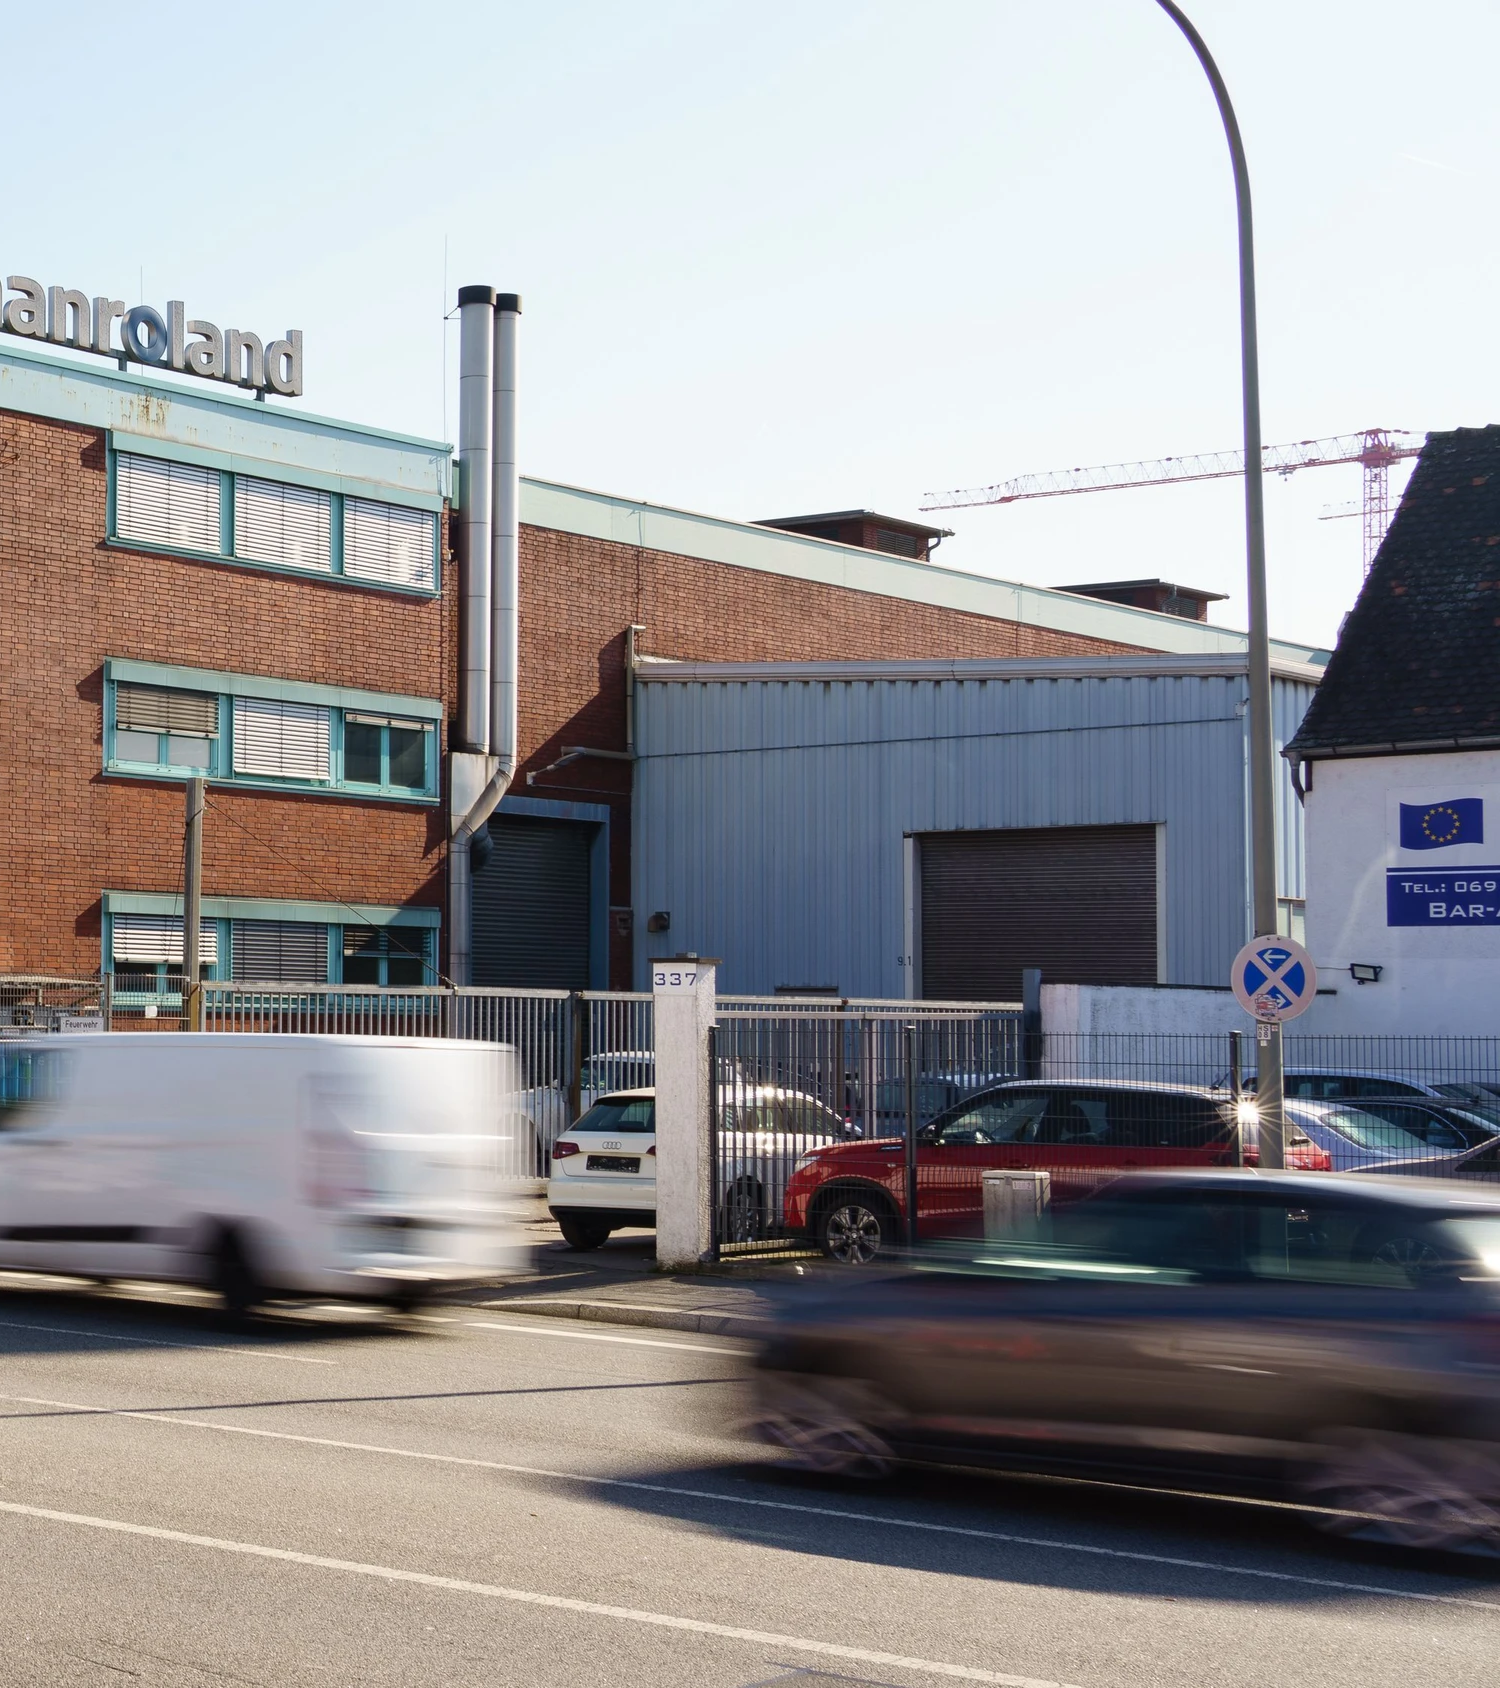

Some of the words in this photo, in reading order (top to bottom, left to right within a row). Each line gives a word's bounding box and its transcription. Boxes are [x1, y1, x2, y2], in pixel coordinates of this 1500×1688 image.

[1454, 881, 1497, 893] 069
[897, 956, 911, 966] 9.1
[654, 973, 697, 986] 337
[65, 1020, 98, 1028] Feuerwehr
